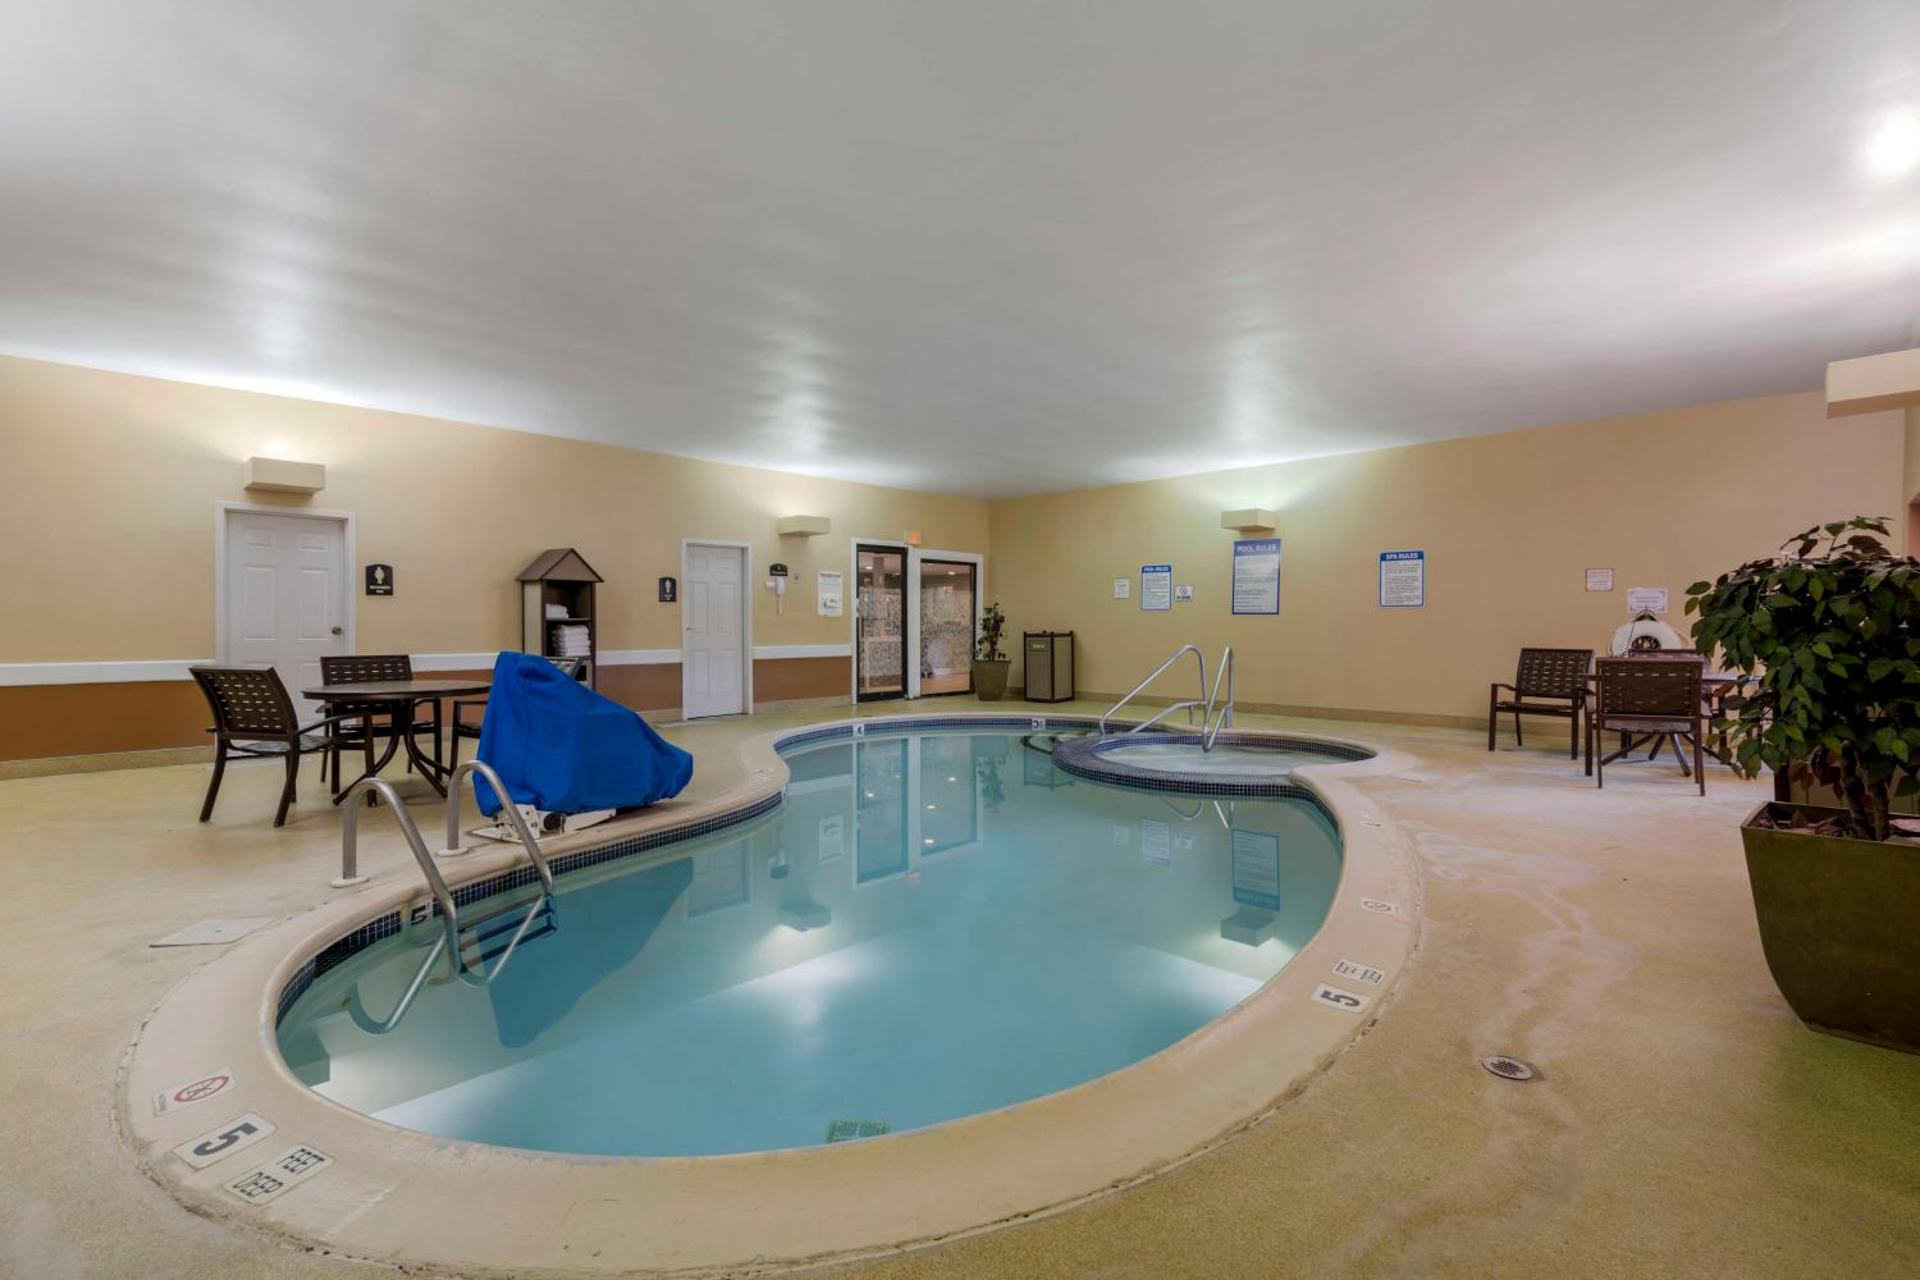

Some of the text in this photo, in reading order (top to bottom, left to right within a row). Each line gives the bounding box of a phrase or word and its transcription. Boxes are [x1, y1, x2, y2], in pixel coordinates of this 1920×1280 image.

[1237, 544, 1277, 553] POOL RULES
[1320, 990, 1360, 1006] 5
[193, 1123, 258, 1156] 5
[277, 1148, 325, 1174] FEET
[232, 1172, 284, 1198] DEEP
